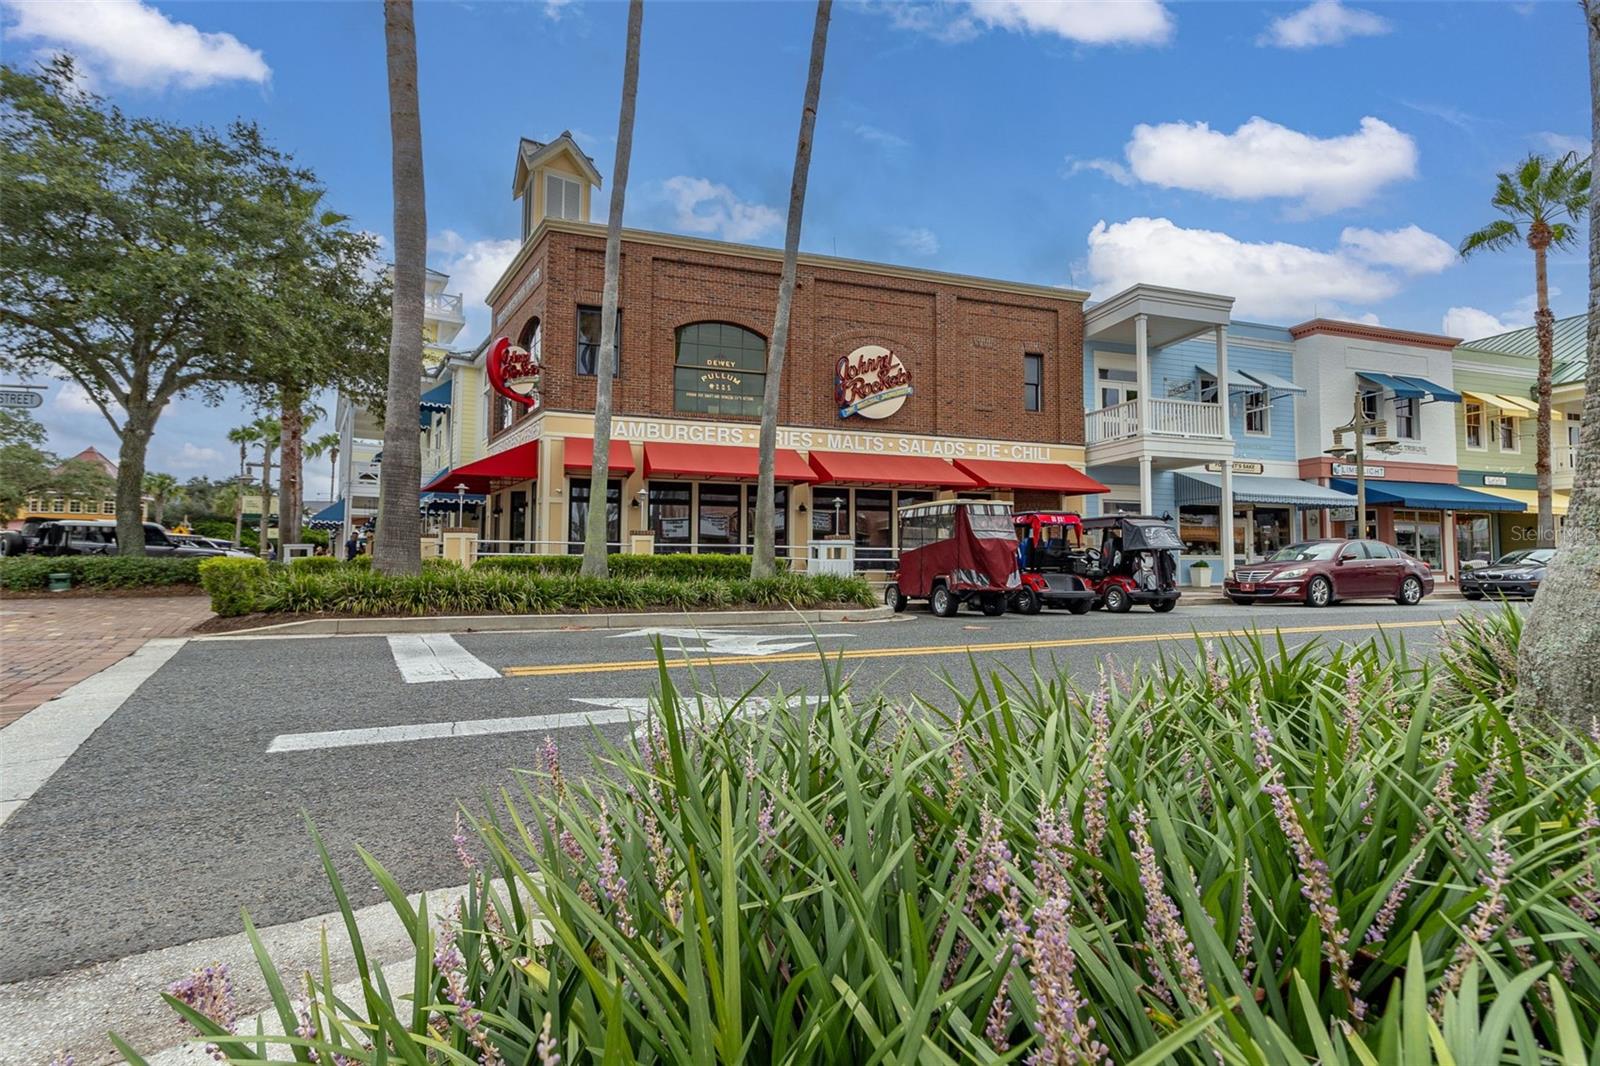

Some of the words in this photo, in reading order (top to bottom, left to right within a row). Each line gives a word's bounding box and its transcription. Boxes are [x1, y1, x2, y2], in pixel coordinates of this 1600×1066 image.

[701, 373, 741, 385] PULLUM
[707, 359, 736, 367] DEWEY
[835, 349, 900, 404] Johnny
[846, 368, 913, 403] Rockets
[610, 420, 743, 444] AMBURGERS
[776, 430, 812, 448] RIES
[827, 433, 884, 451] MALTS
[898, 438, 965, 457] SALADS
[976, 443, 1001, 458] PIE
[1011, 445, 1050, 460] CHILI
